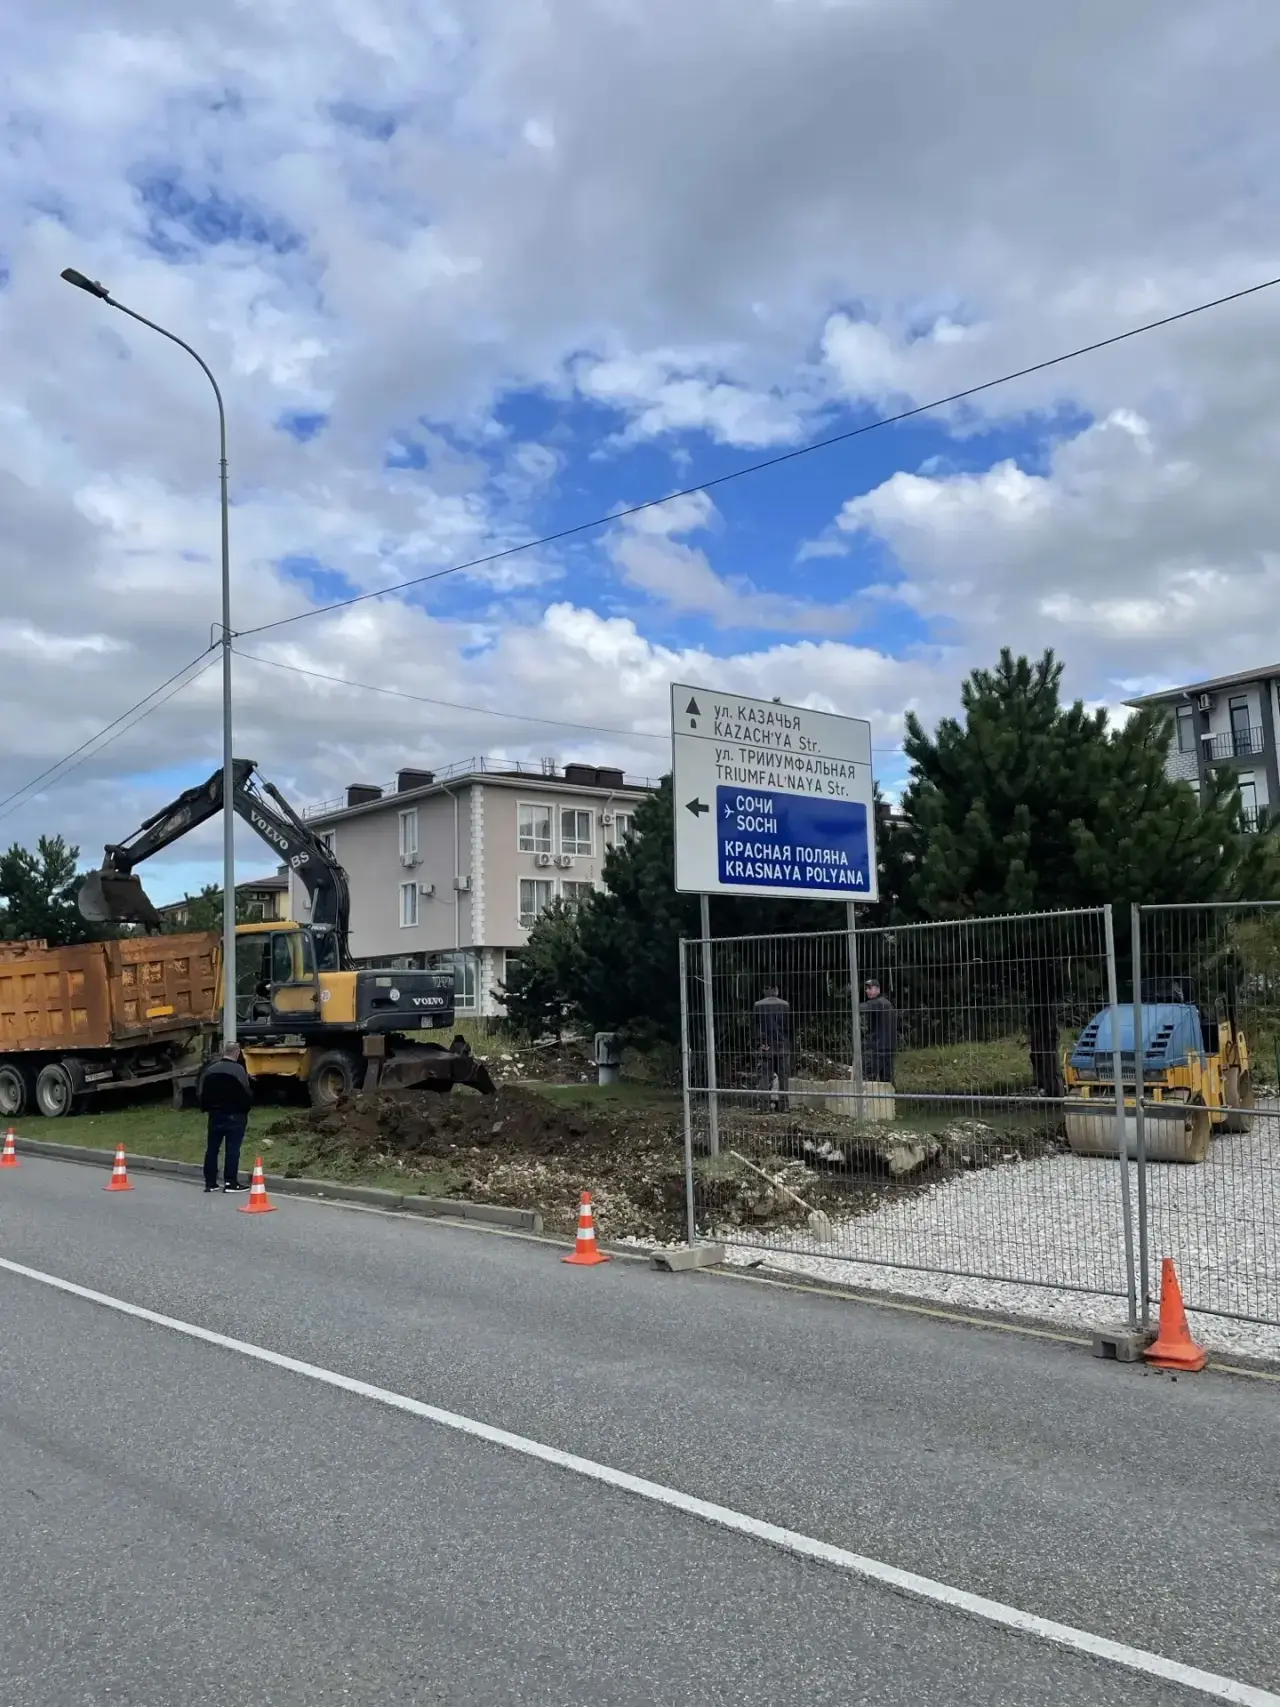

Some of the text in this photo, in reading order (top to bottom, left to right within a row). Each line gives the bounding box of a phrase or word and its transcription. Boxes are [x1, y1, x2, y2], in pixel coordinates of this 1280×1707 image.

[714, 705, 801, 731] ул. КАЗАЧЬЯ
[714, 721, 821, 753] KAZACH'YA Str.
[715, 748, 855, 779] ул. ТРИИУМФАЛЬНАЯ
[716, 764, 849, 797] TRIUMFAL'NAYA Str.
[736, 795, 773, 814] СОЧИ
[251, 810, 289, 850] VOLVO
[737, 815, 777, 834] SOCHI
[725, 841, 848, 866] КРАСНАЯ ПОЛЯНА
[725, 860, 864, 885] KRASNAYA POLYANA
[412, 997, 444, 1006] VOLVO
